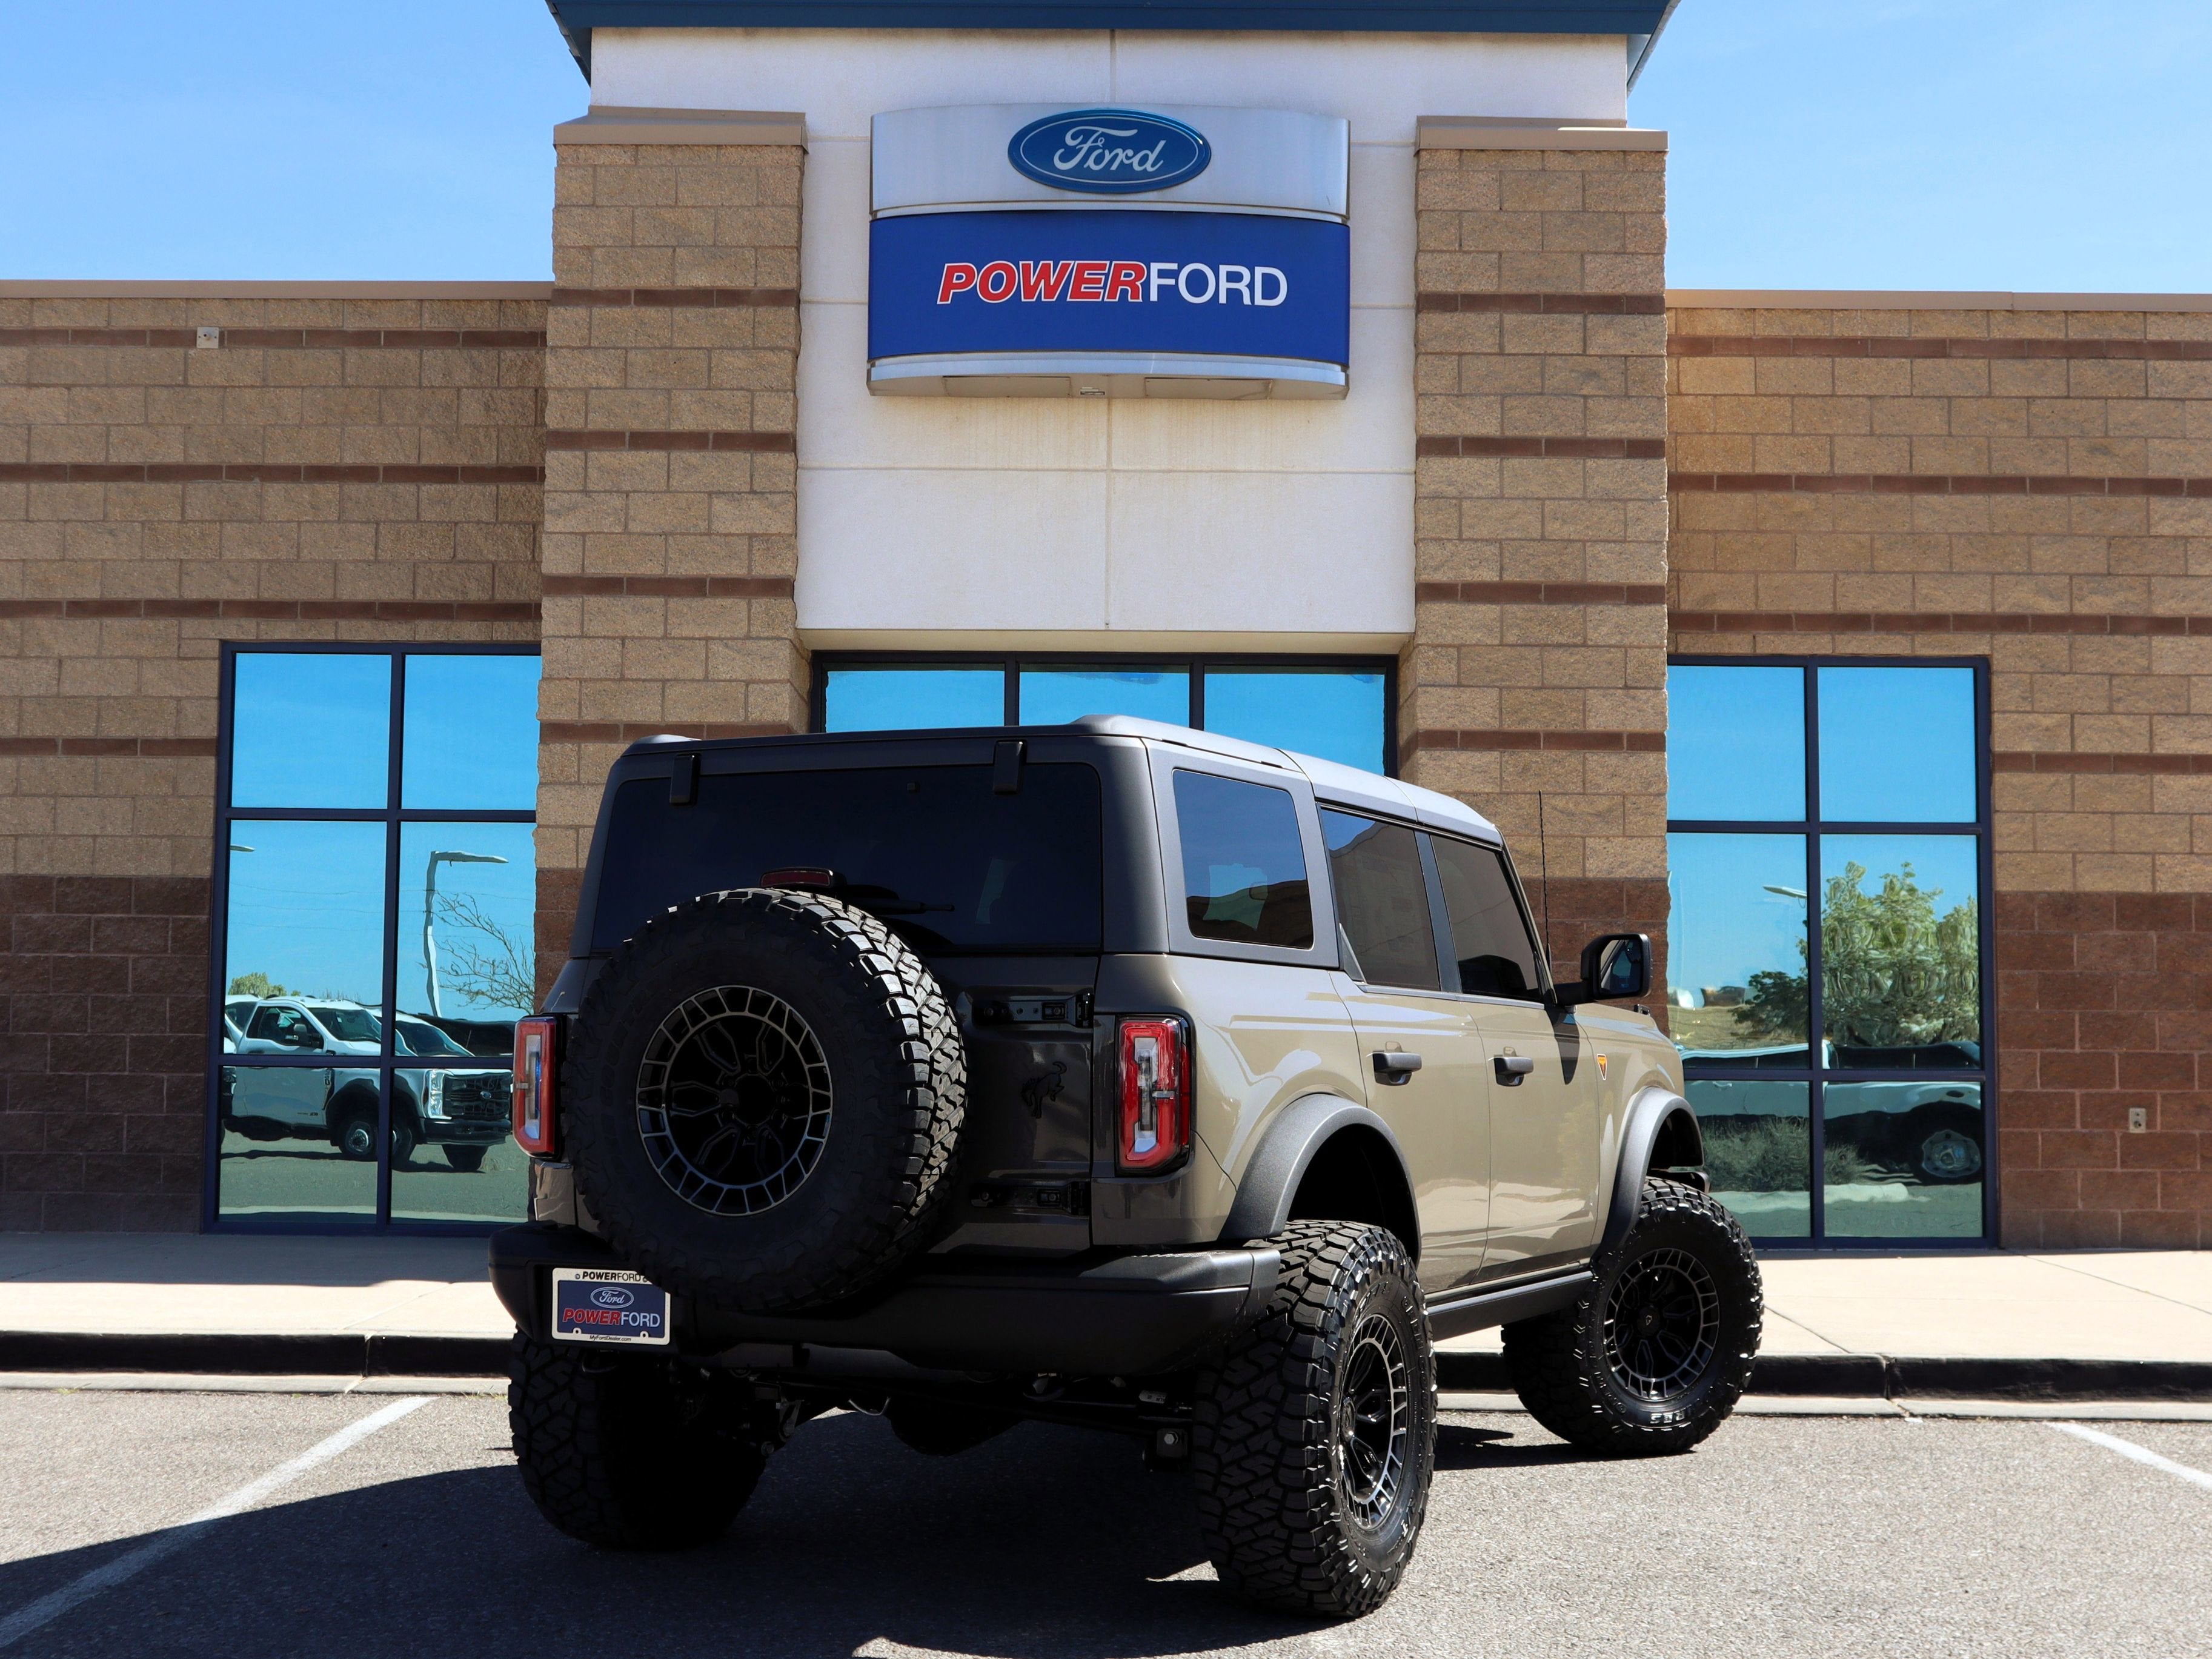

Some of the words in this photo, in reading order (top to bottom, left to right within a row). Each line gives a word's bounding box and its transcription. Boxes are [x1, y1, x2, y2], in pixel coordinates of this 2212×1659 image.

[1053, 125, 1167, 173] Ford
[936, 261, 1288, 306] POWERFORD
[599, 1289, 625, 1304] Ford
[562, 1308, 660, 1328] POWERFORD
